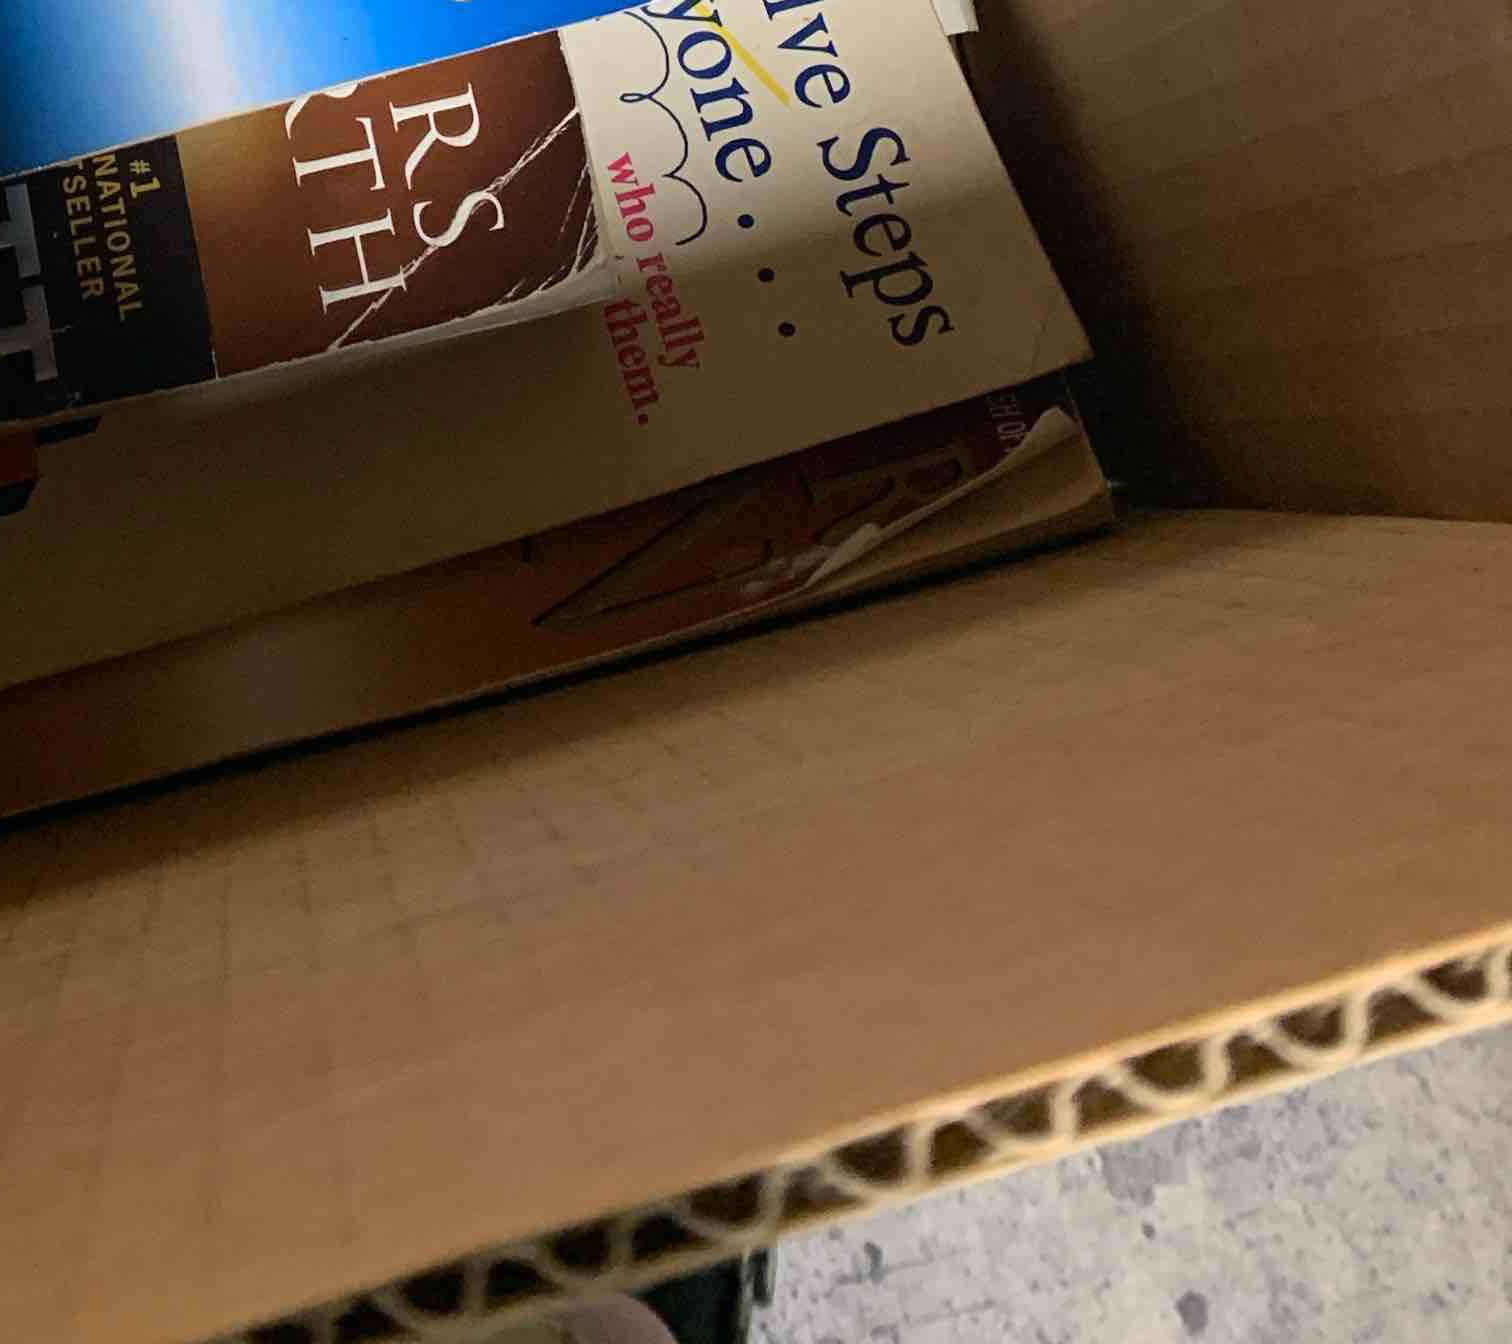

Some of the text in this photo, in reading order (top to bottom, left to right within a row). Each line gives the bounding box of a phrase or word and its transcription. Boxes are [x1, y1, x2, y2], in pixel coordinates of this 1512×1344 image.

[91, 152, 144, 321] NATIONAL
[127, 158, 162, 199] #1
[389, 82, 506, 249] RS
[815, 126, 955, 348] Steps
[607, 151, 705, 369] who really
[602, 298, 660, 426] them.
